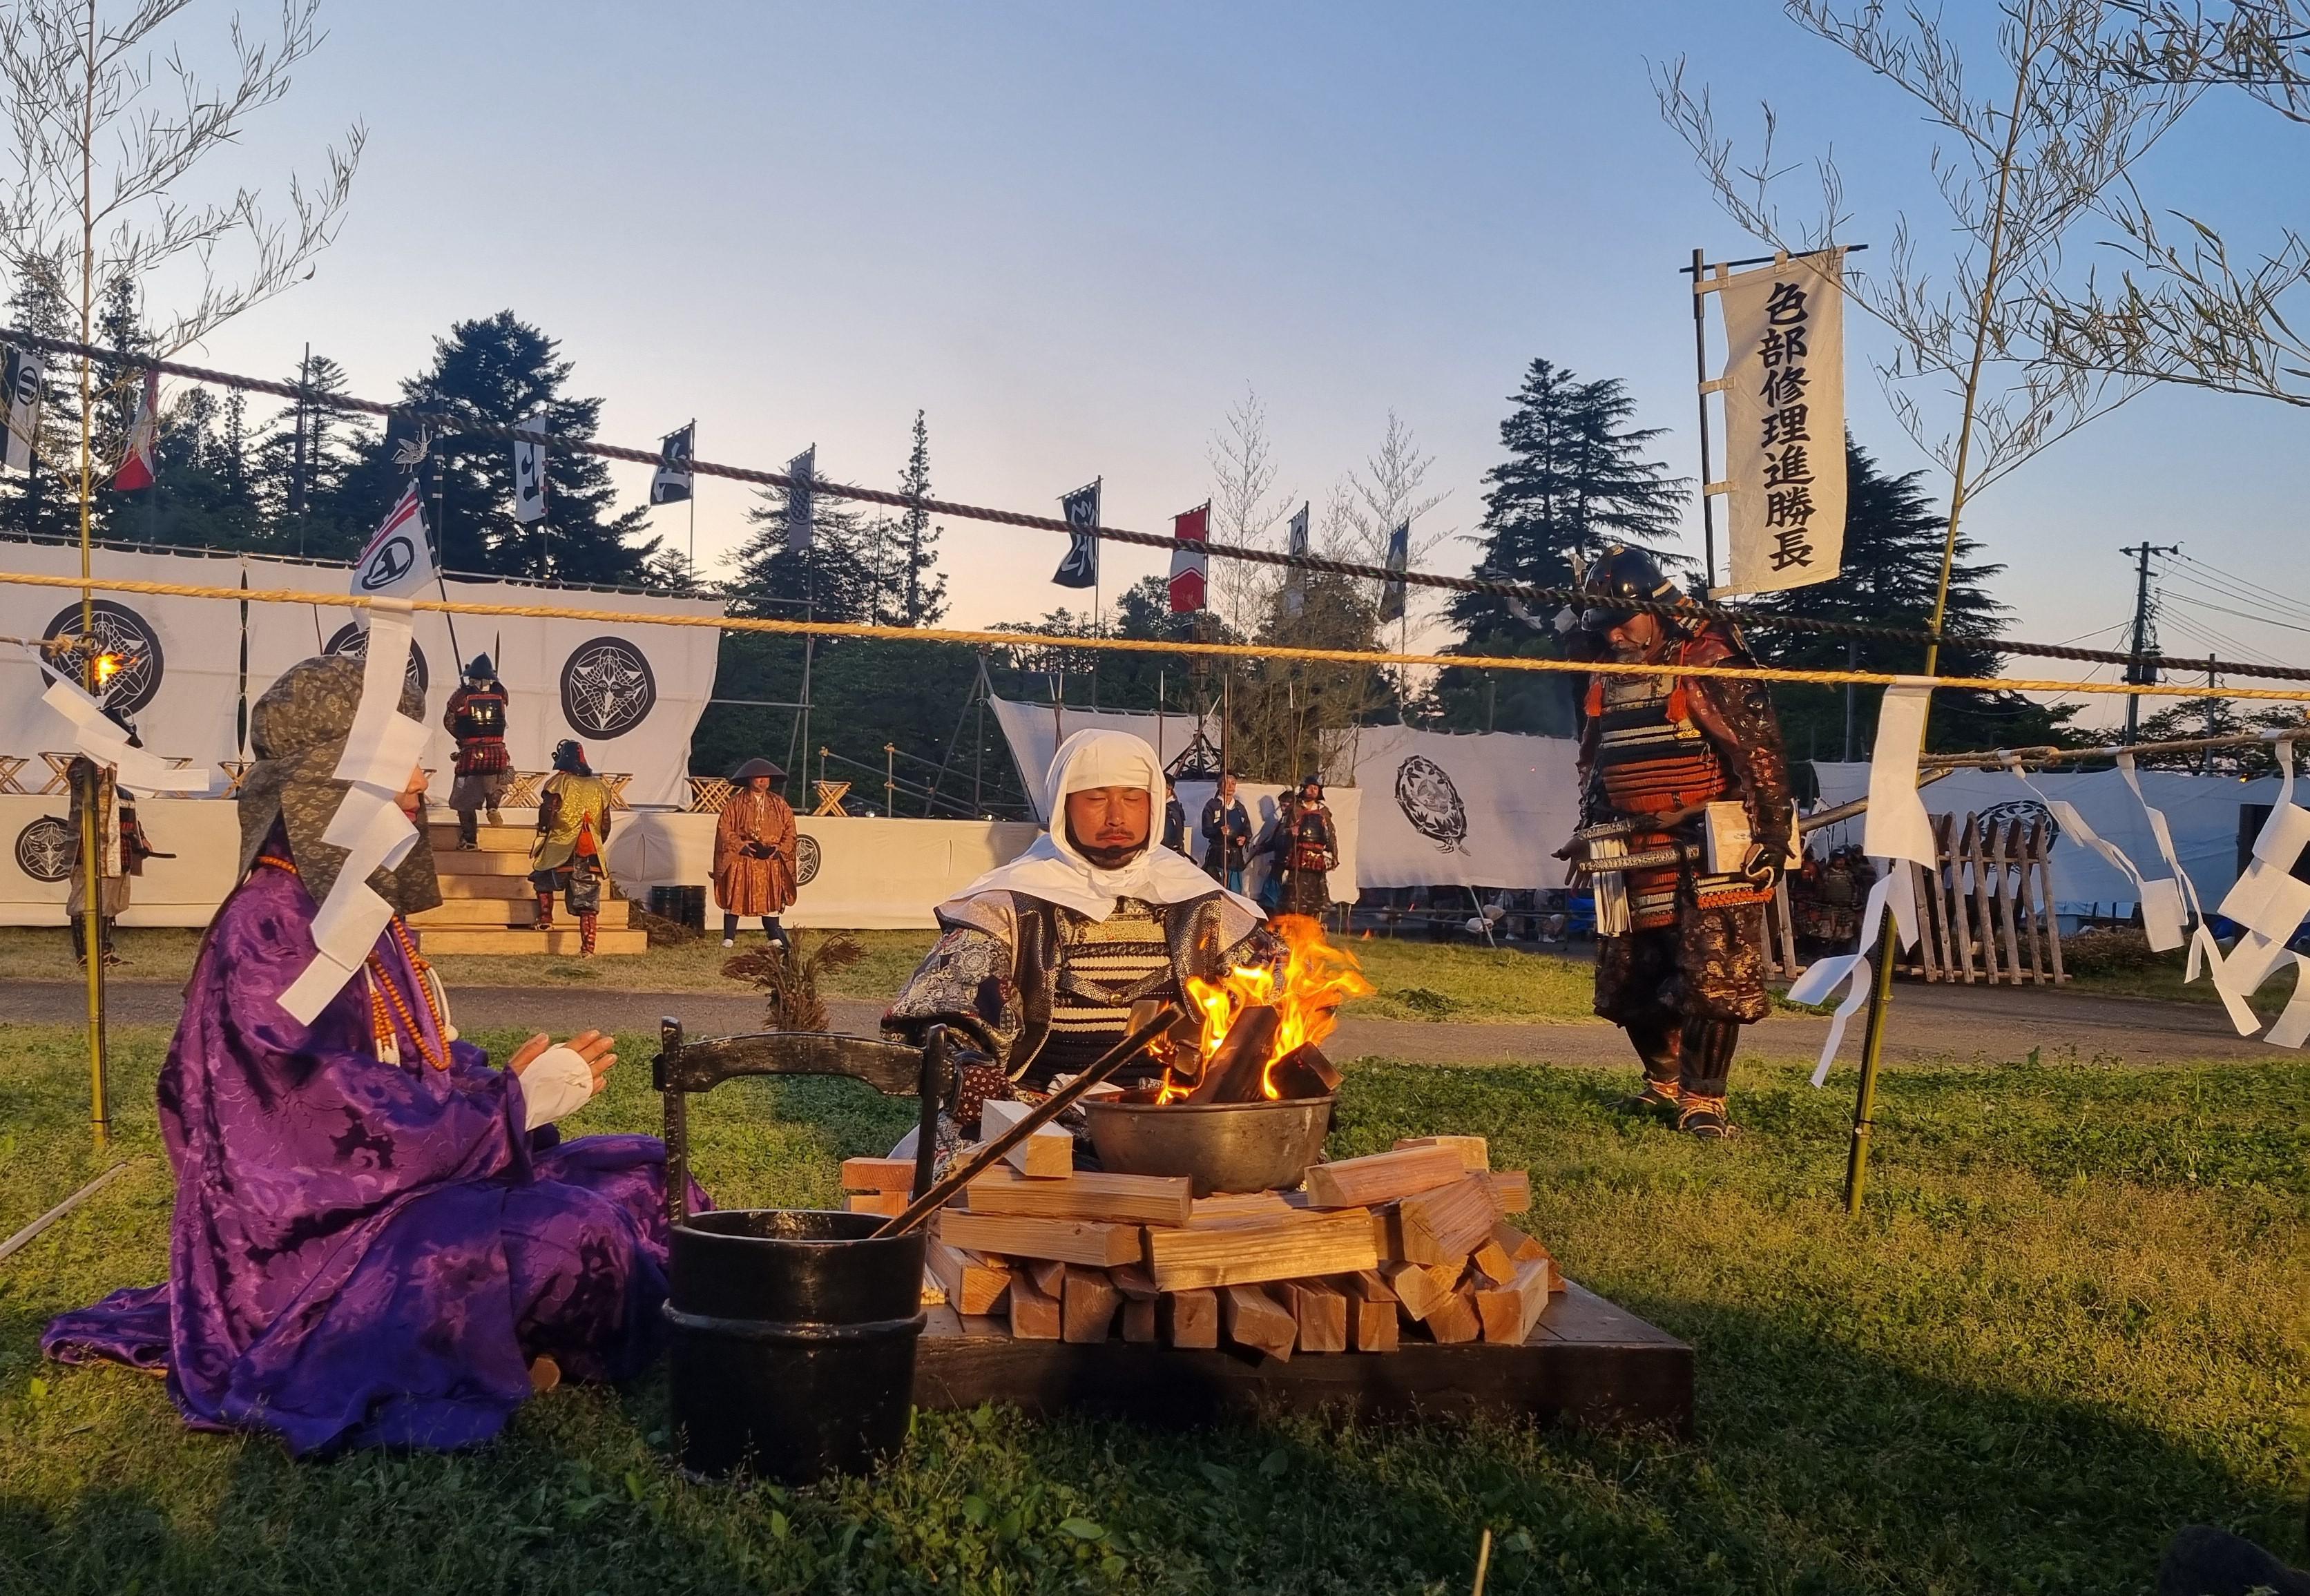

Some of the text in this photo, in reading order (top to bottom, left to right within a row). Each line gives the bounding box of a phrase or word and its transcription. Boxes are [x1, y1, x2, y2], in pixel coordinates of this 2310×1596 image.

[1758, 282, 1818, 573] 色部修理進勝長
